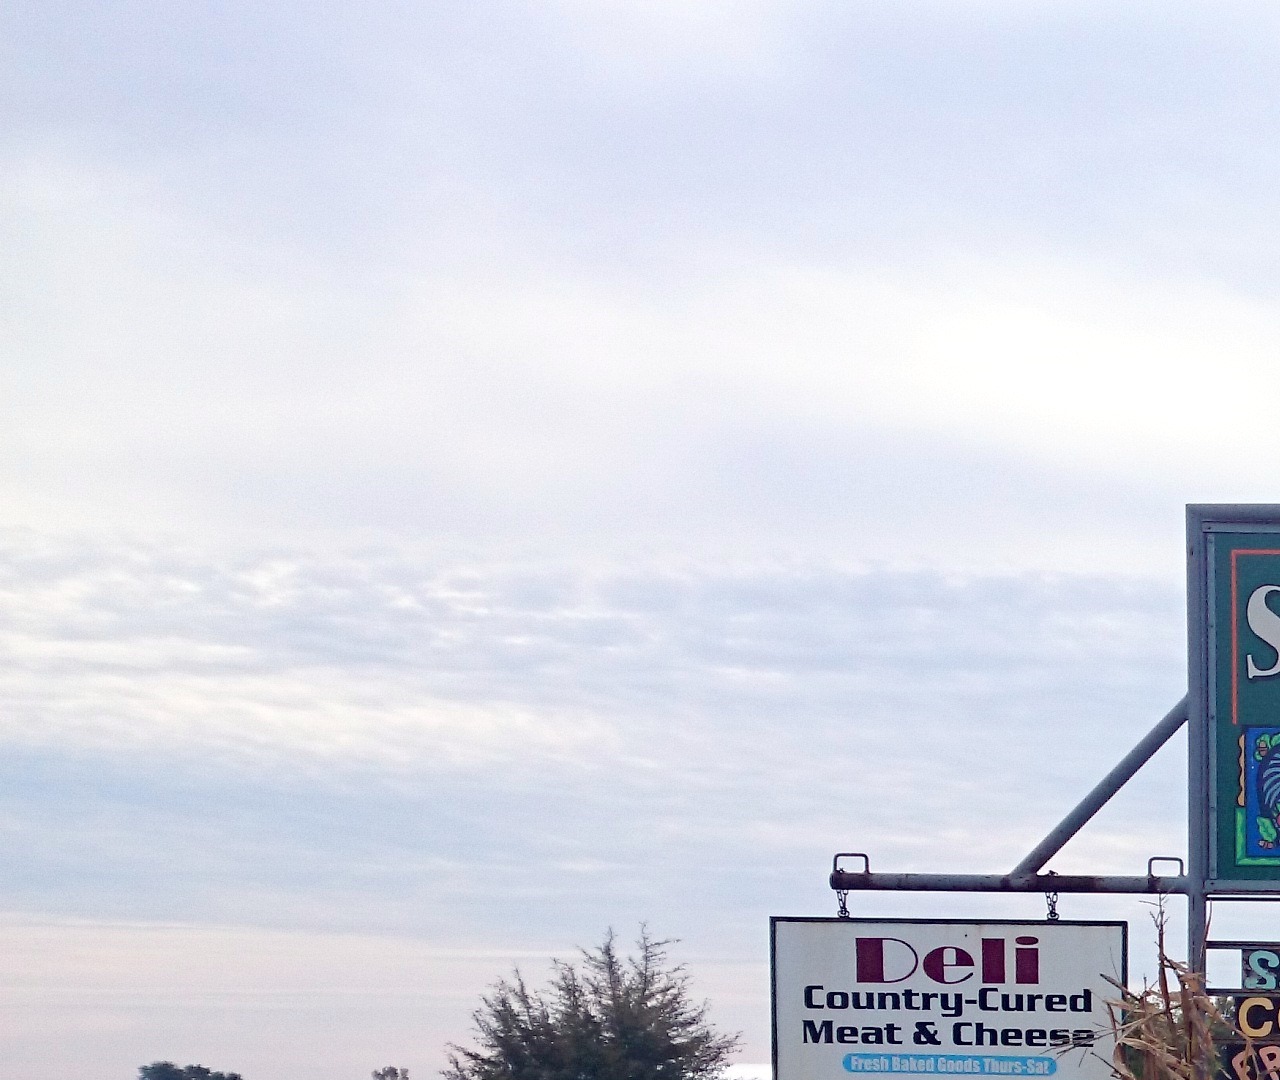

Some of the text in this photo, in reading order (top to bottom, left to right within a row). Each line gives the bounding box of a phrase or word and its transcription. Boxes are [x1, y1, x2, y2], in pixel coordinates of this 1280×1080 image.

[855, 936, 1039, 984] Deli
[804, 985, 1092, 1017] Country-Cured
[803, 1020, 1094, 1047] Meat & Cheese
[851, 1056, 1049, 1075] Fresh Baked Goods Thurs-Sat
